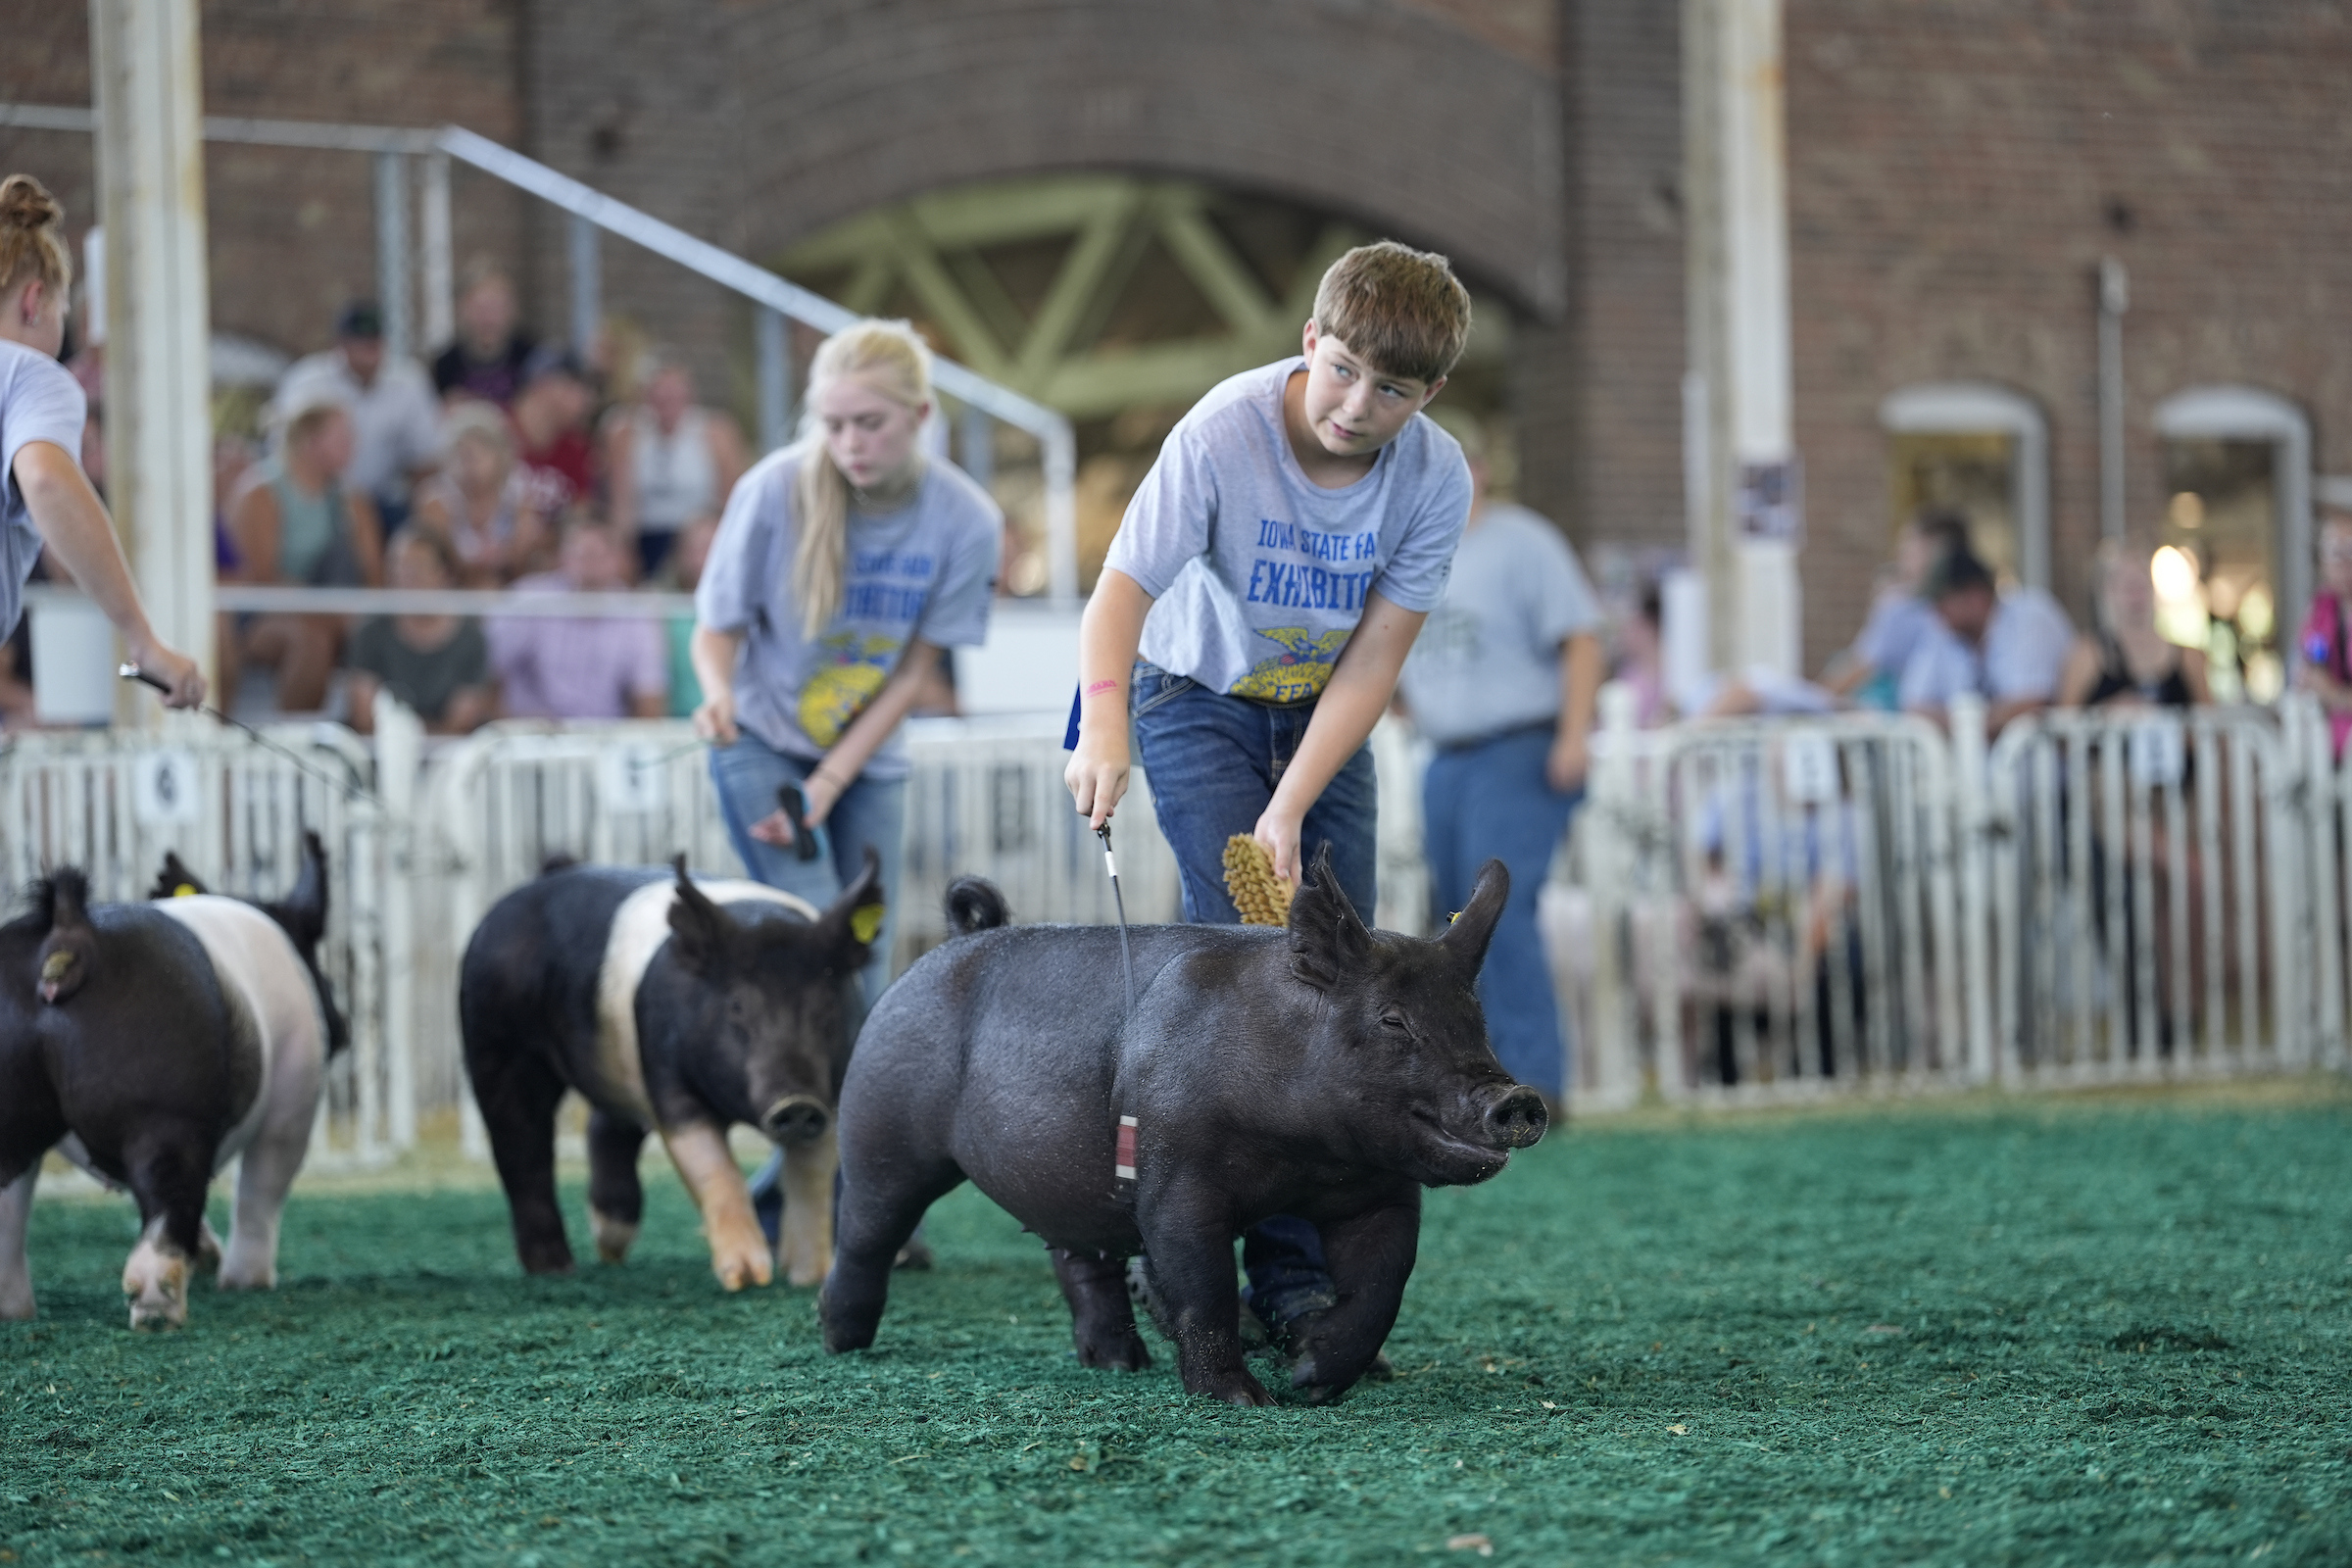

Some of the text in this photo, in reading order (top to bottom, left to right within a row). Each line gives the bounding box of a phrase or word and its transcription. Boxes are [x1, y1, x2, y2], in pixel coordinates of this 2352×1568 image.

[1257, 519, 1376, 562] IOWA STATE FA
[1247, 558, 1374, 611] EXHIBITO
[1275, 682, 1312, 702] FFA
